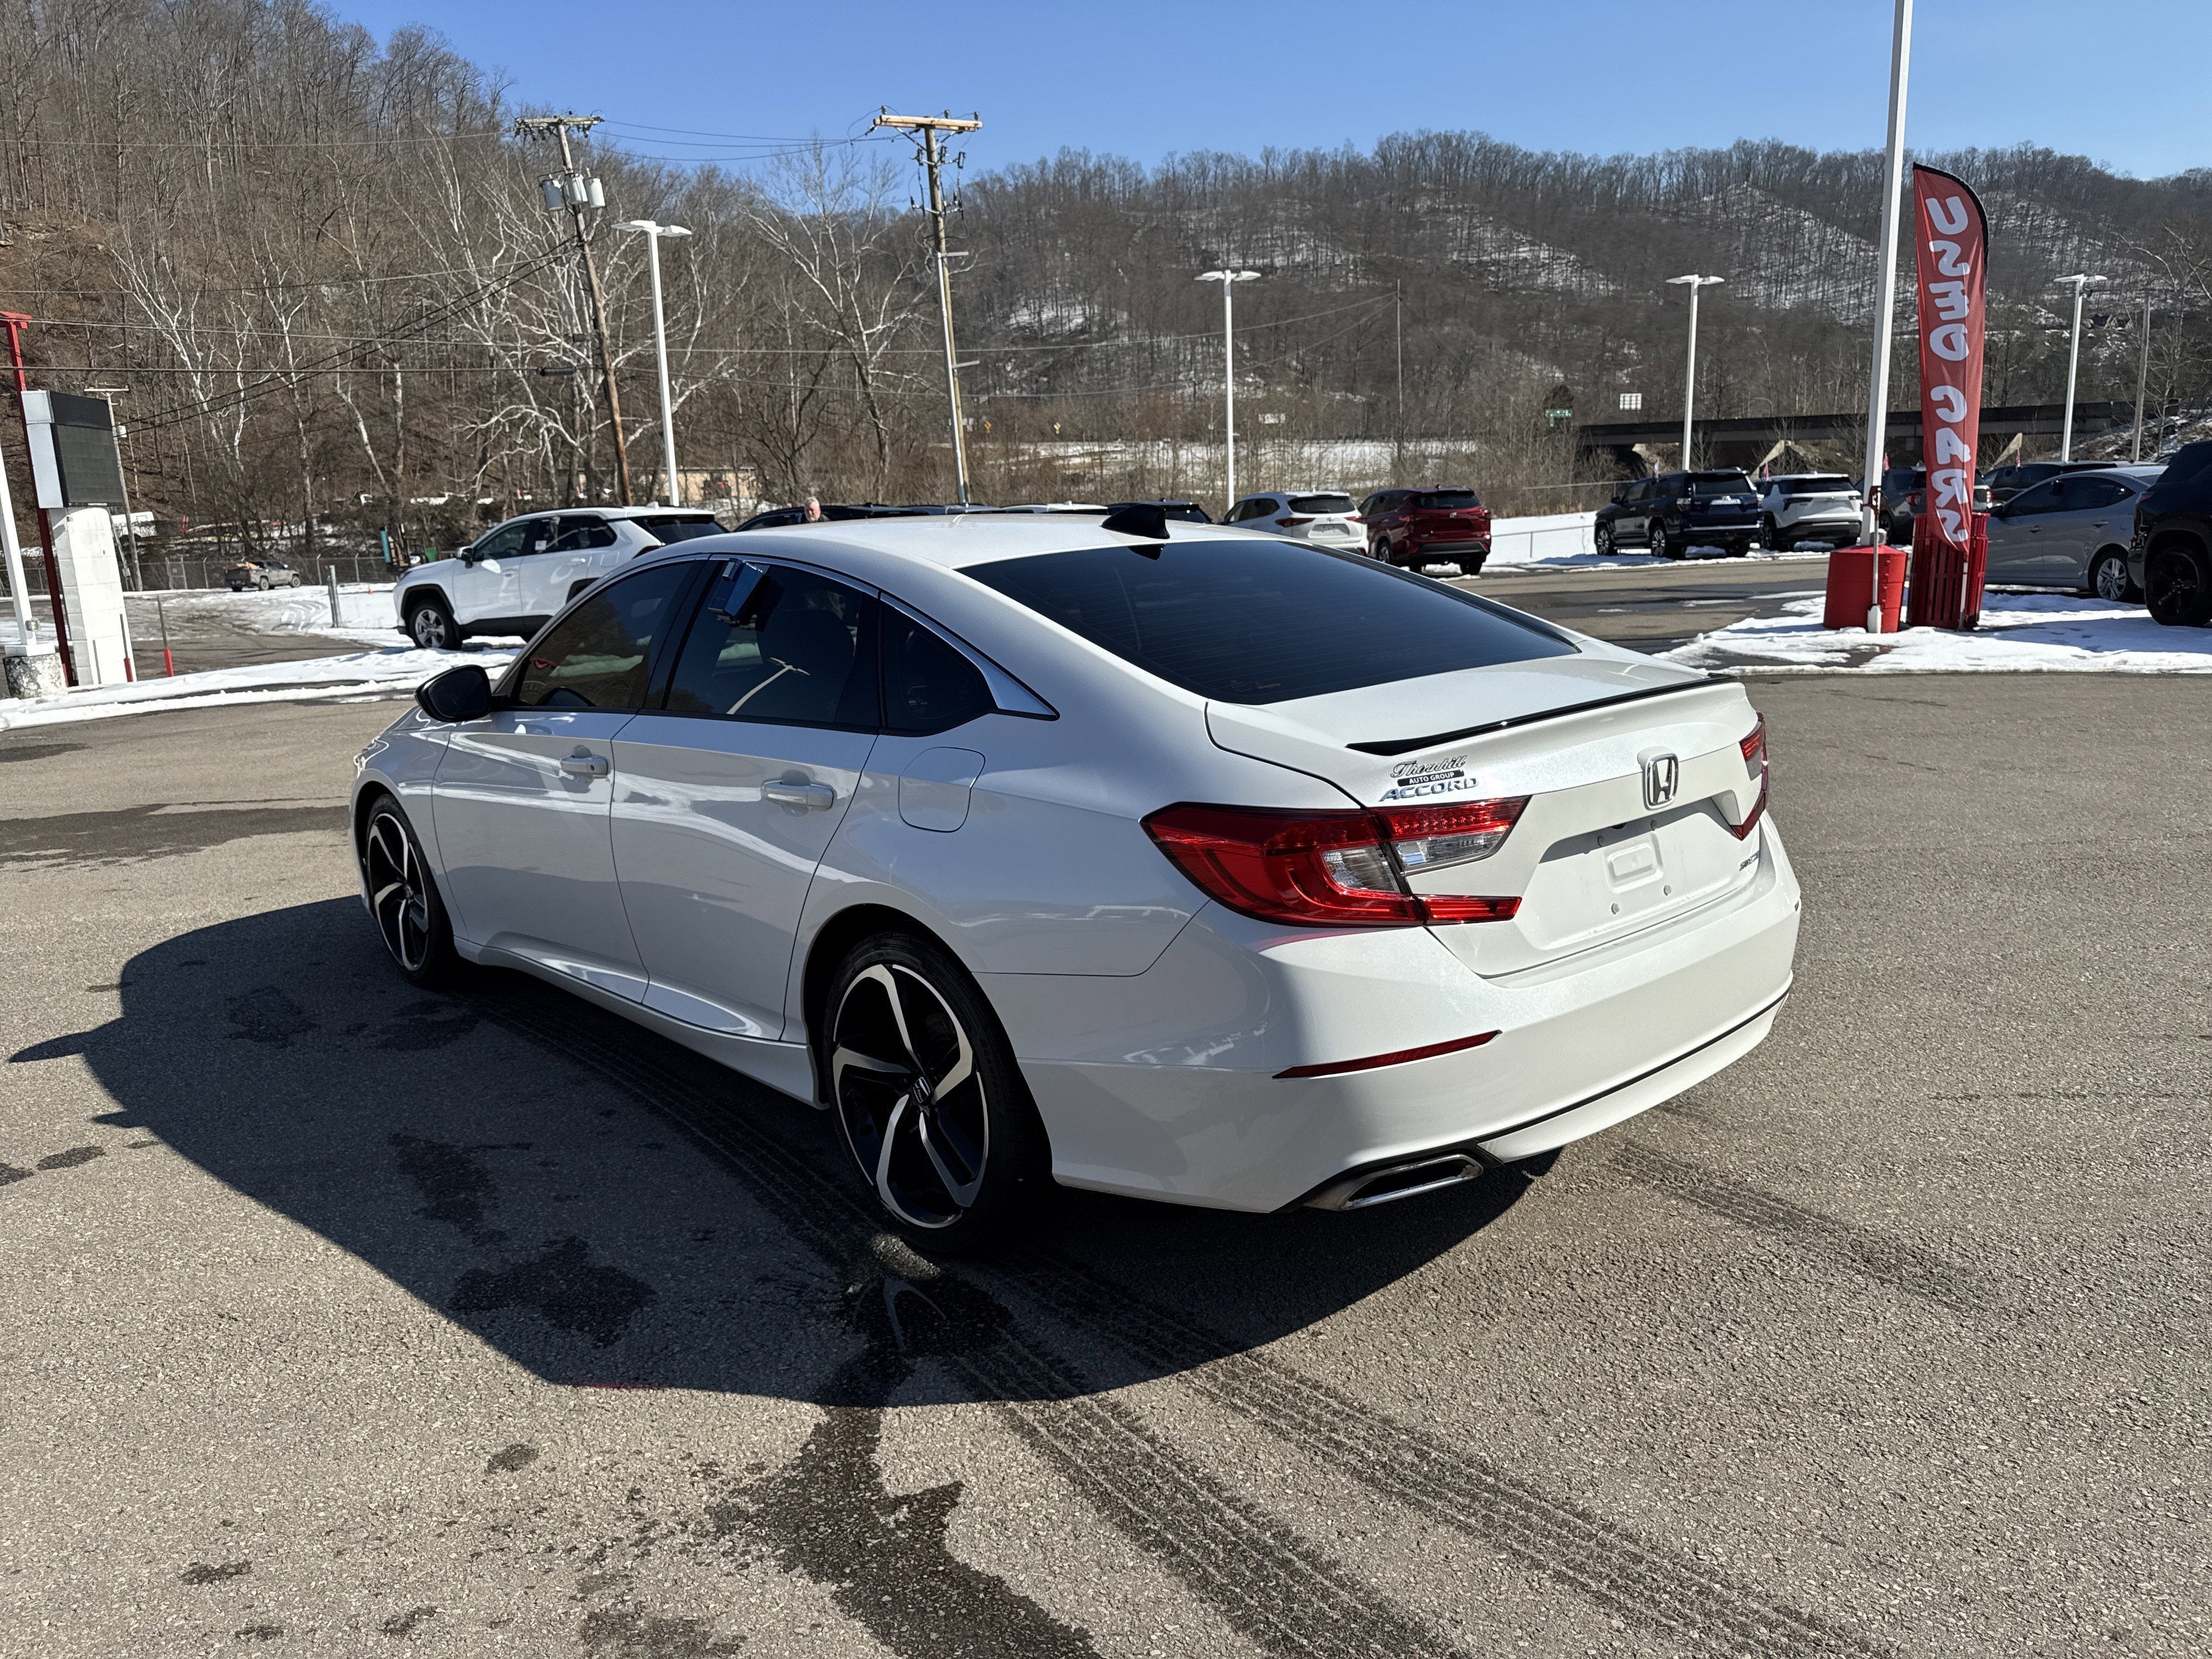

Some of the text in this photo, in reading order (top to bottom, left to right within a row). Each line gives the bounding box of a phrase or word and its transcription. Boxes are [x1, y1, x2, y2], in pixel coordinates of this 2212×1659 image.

[1390, 755, 1468, 778] Thornhill
[1408, 771, 1455, 785] AUTO GROUP
[1379, 777, 1479, 802] ACCORD
